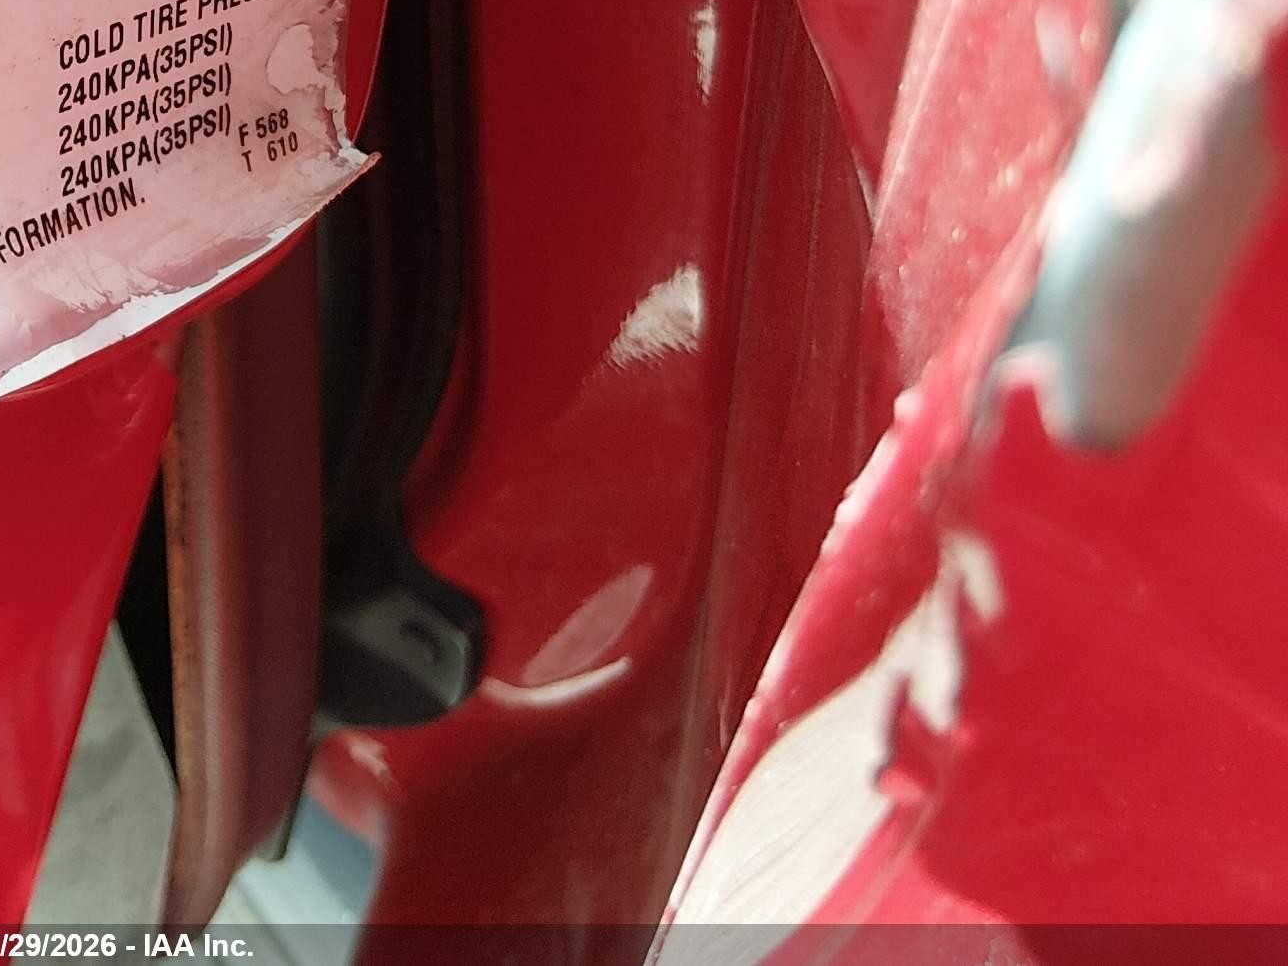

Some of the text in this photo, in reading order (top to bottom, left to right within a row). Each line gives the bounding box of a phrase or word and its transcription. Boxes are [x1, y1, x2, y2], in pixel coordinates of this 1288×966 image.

[57, 21, 233, 114] 240KPA(35PSI)
[59, 21, 125, 71] COLD
[58, 61, 232, 156] 240KPA(35PSI)
[237, 107, 290, 147] F 568
[60, 102, 232, 198] 240KPA(35PSI)
[240, 130, 299, 173] T 610
